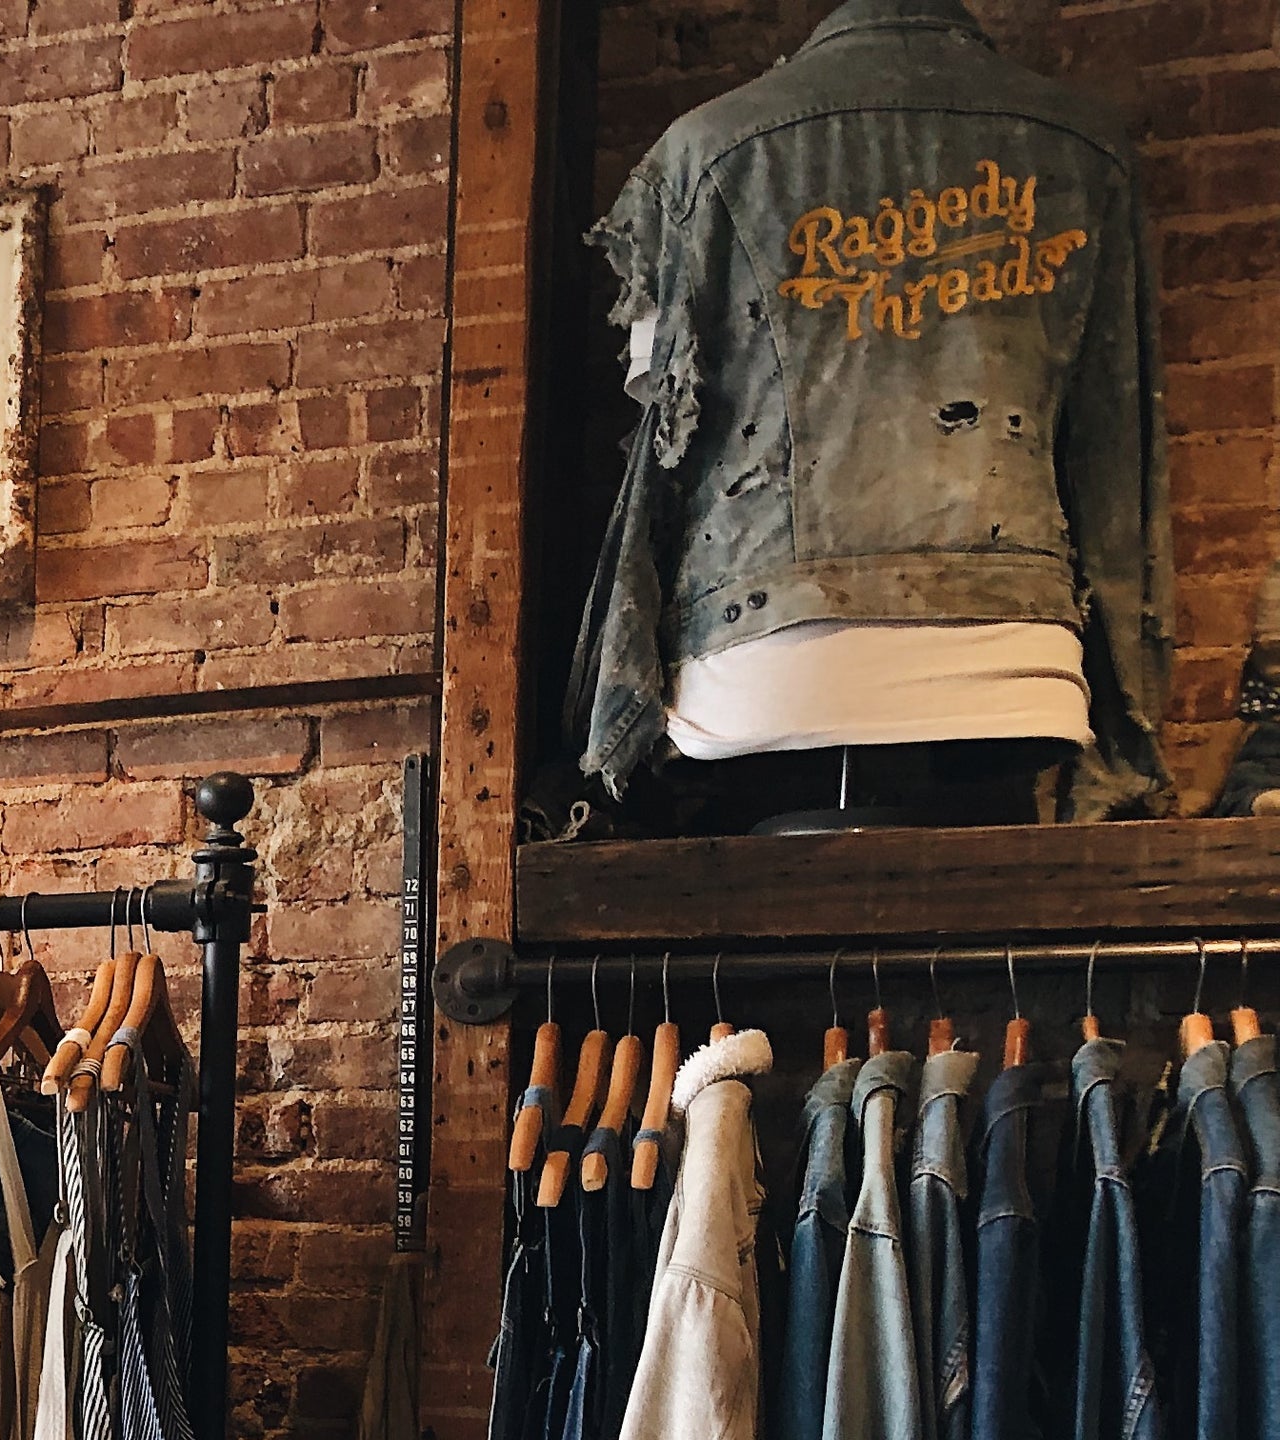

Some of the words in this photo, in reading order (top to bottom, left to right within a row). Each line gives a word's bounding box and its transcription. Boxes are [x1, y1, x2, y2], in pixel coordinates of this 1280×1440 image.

[790, 159, 1037, 276] Raggedy
[777, 229, 1088, 340] Threads
[404, 879, 418, 892] 72
[404, 903, 414, 916] 71
[404, 927, 417, 940] 70
[403, 951, 417, 965] 69
[402, 975, 416, 989] 68
[402, 999, 416, 1012] 67
[401, 1023, 415, 1037] 66
[401, 1047, 415, 1061] 65
[400, 1071, 415, 1085] 64
[400, 1095, 414, 1108] 63
[399, 1119, 414, 1132] 62
[399, 1143, 410, 1156] 61
[398, 1167, 413, 1180] 60
[398, 1191, 412, 1204] 59
[397, 1214, 412, 1227] 58
